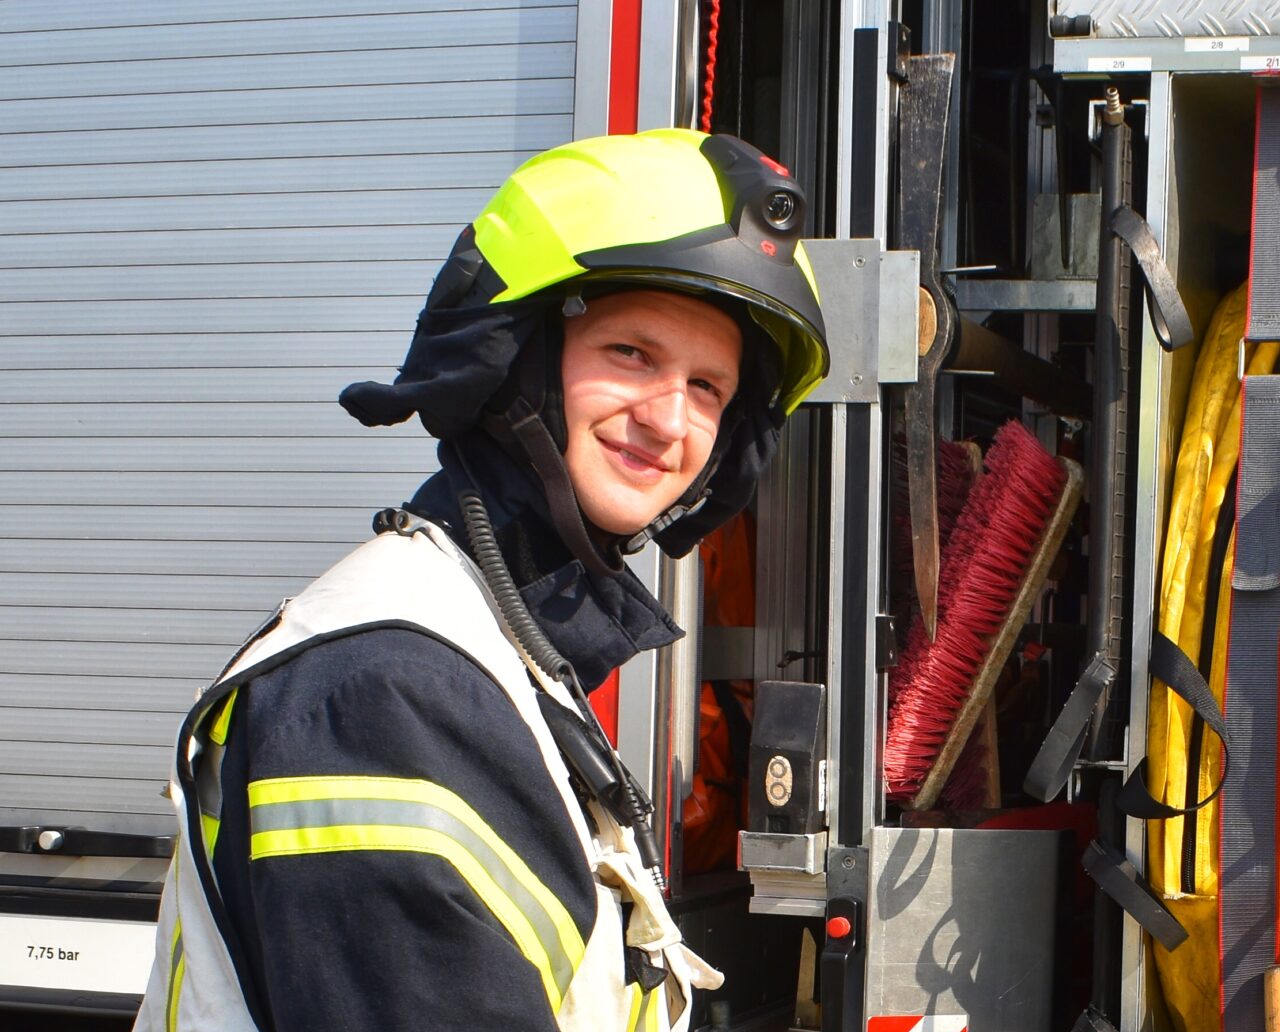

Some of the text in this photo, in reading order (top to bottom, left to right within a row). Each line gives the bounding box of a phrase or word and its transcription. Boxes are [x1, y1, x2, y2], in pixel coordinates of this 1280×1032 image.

[1211, 41, 1223, 49] 2/8
[1113, 60, 1125, 69] 2/9
[27, 945, 80, 961] 7,75 bar
